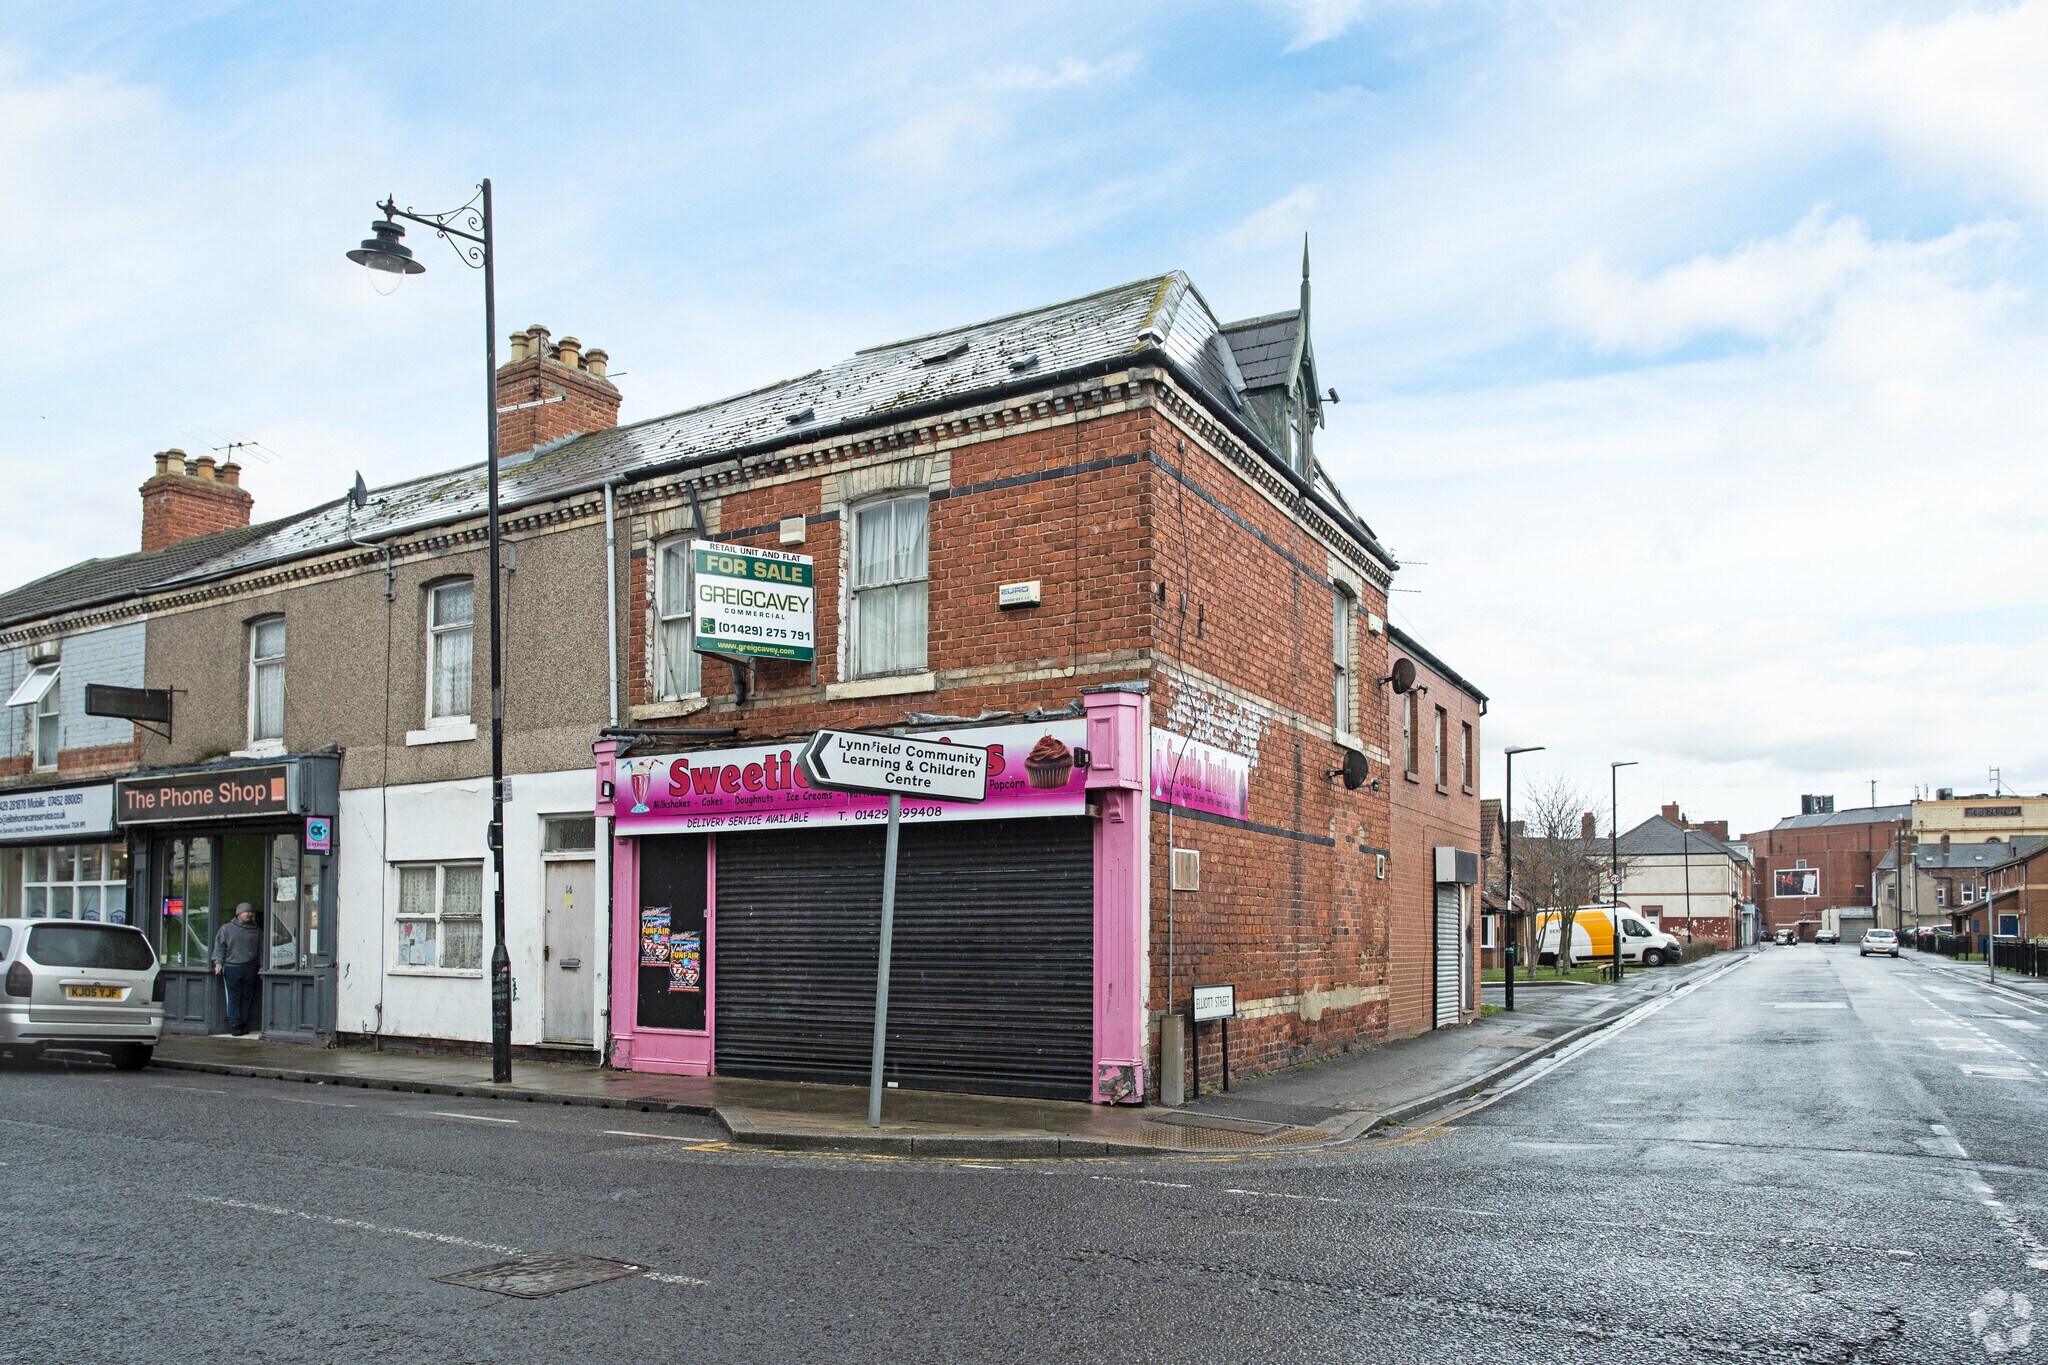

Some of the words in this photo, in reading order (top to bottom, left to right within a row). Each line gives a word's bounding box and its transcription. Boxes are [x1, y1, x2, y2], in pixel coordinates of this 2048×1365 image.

[710, 543, 737, 553] RETAIL
[740, 547, 759, 557] UNIT
[762, 551, 780, 560] AND
[783, 553, 801, 562] FLAT
[706, 555, 747, 576] FOR
[754, 562, 803, 583] SALE
[699, 584, 810, 614] GREIGCAVEY
[724, 608, 786, 620] COMMERCIAL
[719, 622, 763, 637] (01429)
[766, 628, 787, 639] 275
[791, 630, 811, 641] 791
[717, 641, 795, 655] www.greigcavey.com
[838, 737, 901, 755] Lynnfield
[906, 745, 982, 767] Community
[842, 752, 901, 772] Learning
[905, 760, 914, 772] &
[919, 761, 976, 779] Children
[885, 772, 932, 788] Centre
[125, 790, 155, 810] The
[160, 787, 213, 808] Phone
[219, 782, 267, 806] Shop
[653, 799, 691, 809] Milkshakes
[701, 797, 723, 806] Cakes
[734, 795, 774, 806] Doughnuts
[786, 792, 799, 802] Ice
[803, 791, 833, 801] Creams
[989, 779, 1026, 792] Popcorn
[687, 817, 726, 828] DELIVERY
[728, 814, 762, 826] SERVICE
[765, 812, 809, 824] AVAILABLE
[855, 809, 889, 820] 01429
[641, 927, 669, 935] FUNFAIR
[670, 951, 699, 959] FUNFAIR
[71, 987, 97, 997] KJ05
[99, 988, 118, 998] YJF
[1215, 995, 1230, 1008] STREET
